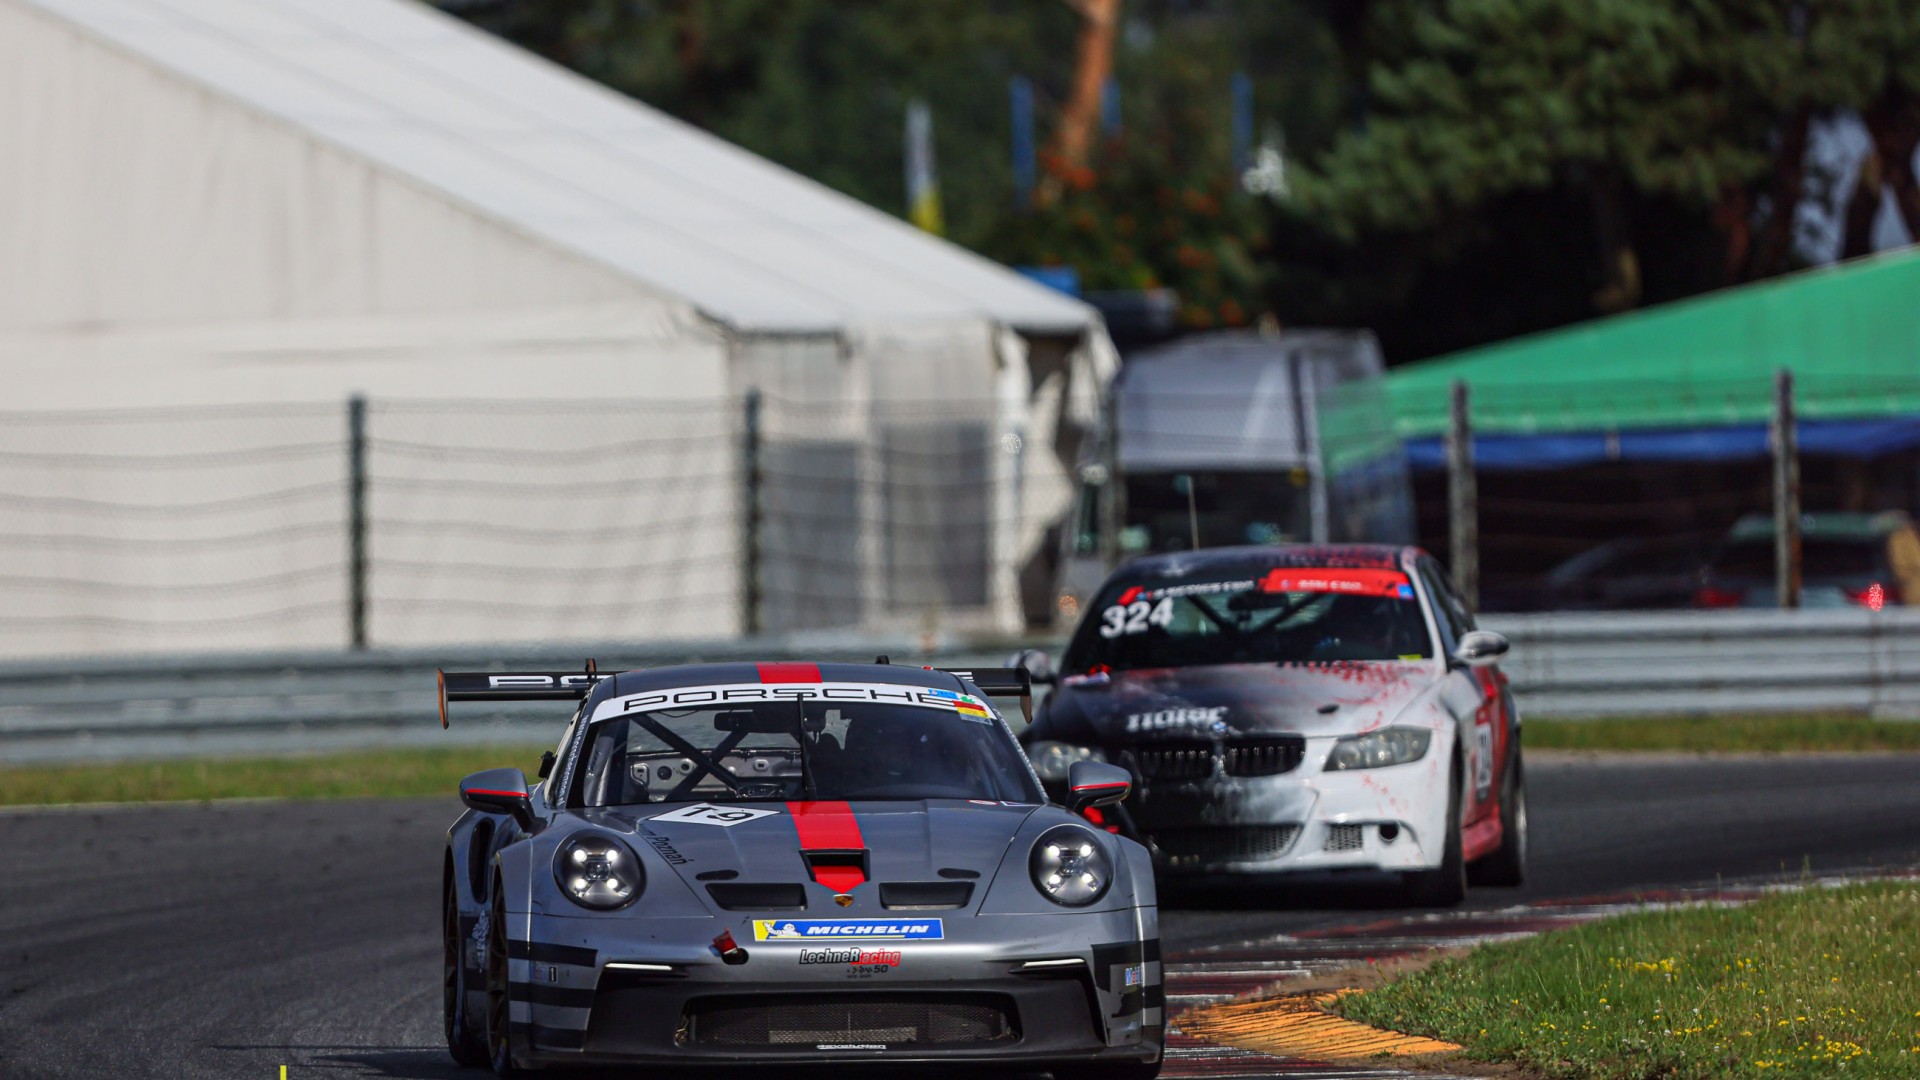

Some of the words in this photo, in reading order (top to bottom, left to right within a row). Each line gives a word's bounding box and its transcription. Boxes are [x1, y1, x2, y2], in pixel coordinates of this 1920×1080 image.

[1101, 596, 1173, 638] 324
[624, 688, 958, 711] PORSCHE
[646, 837, 695, 864] Poznań
[807, 925, 929, 935] MICHELIN
[874, 965, 888, 973] 50
